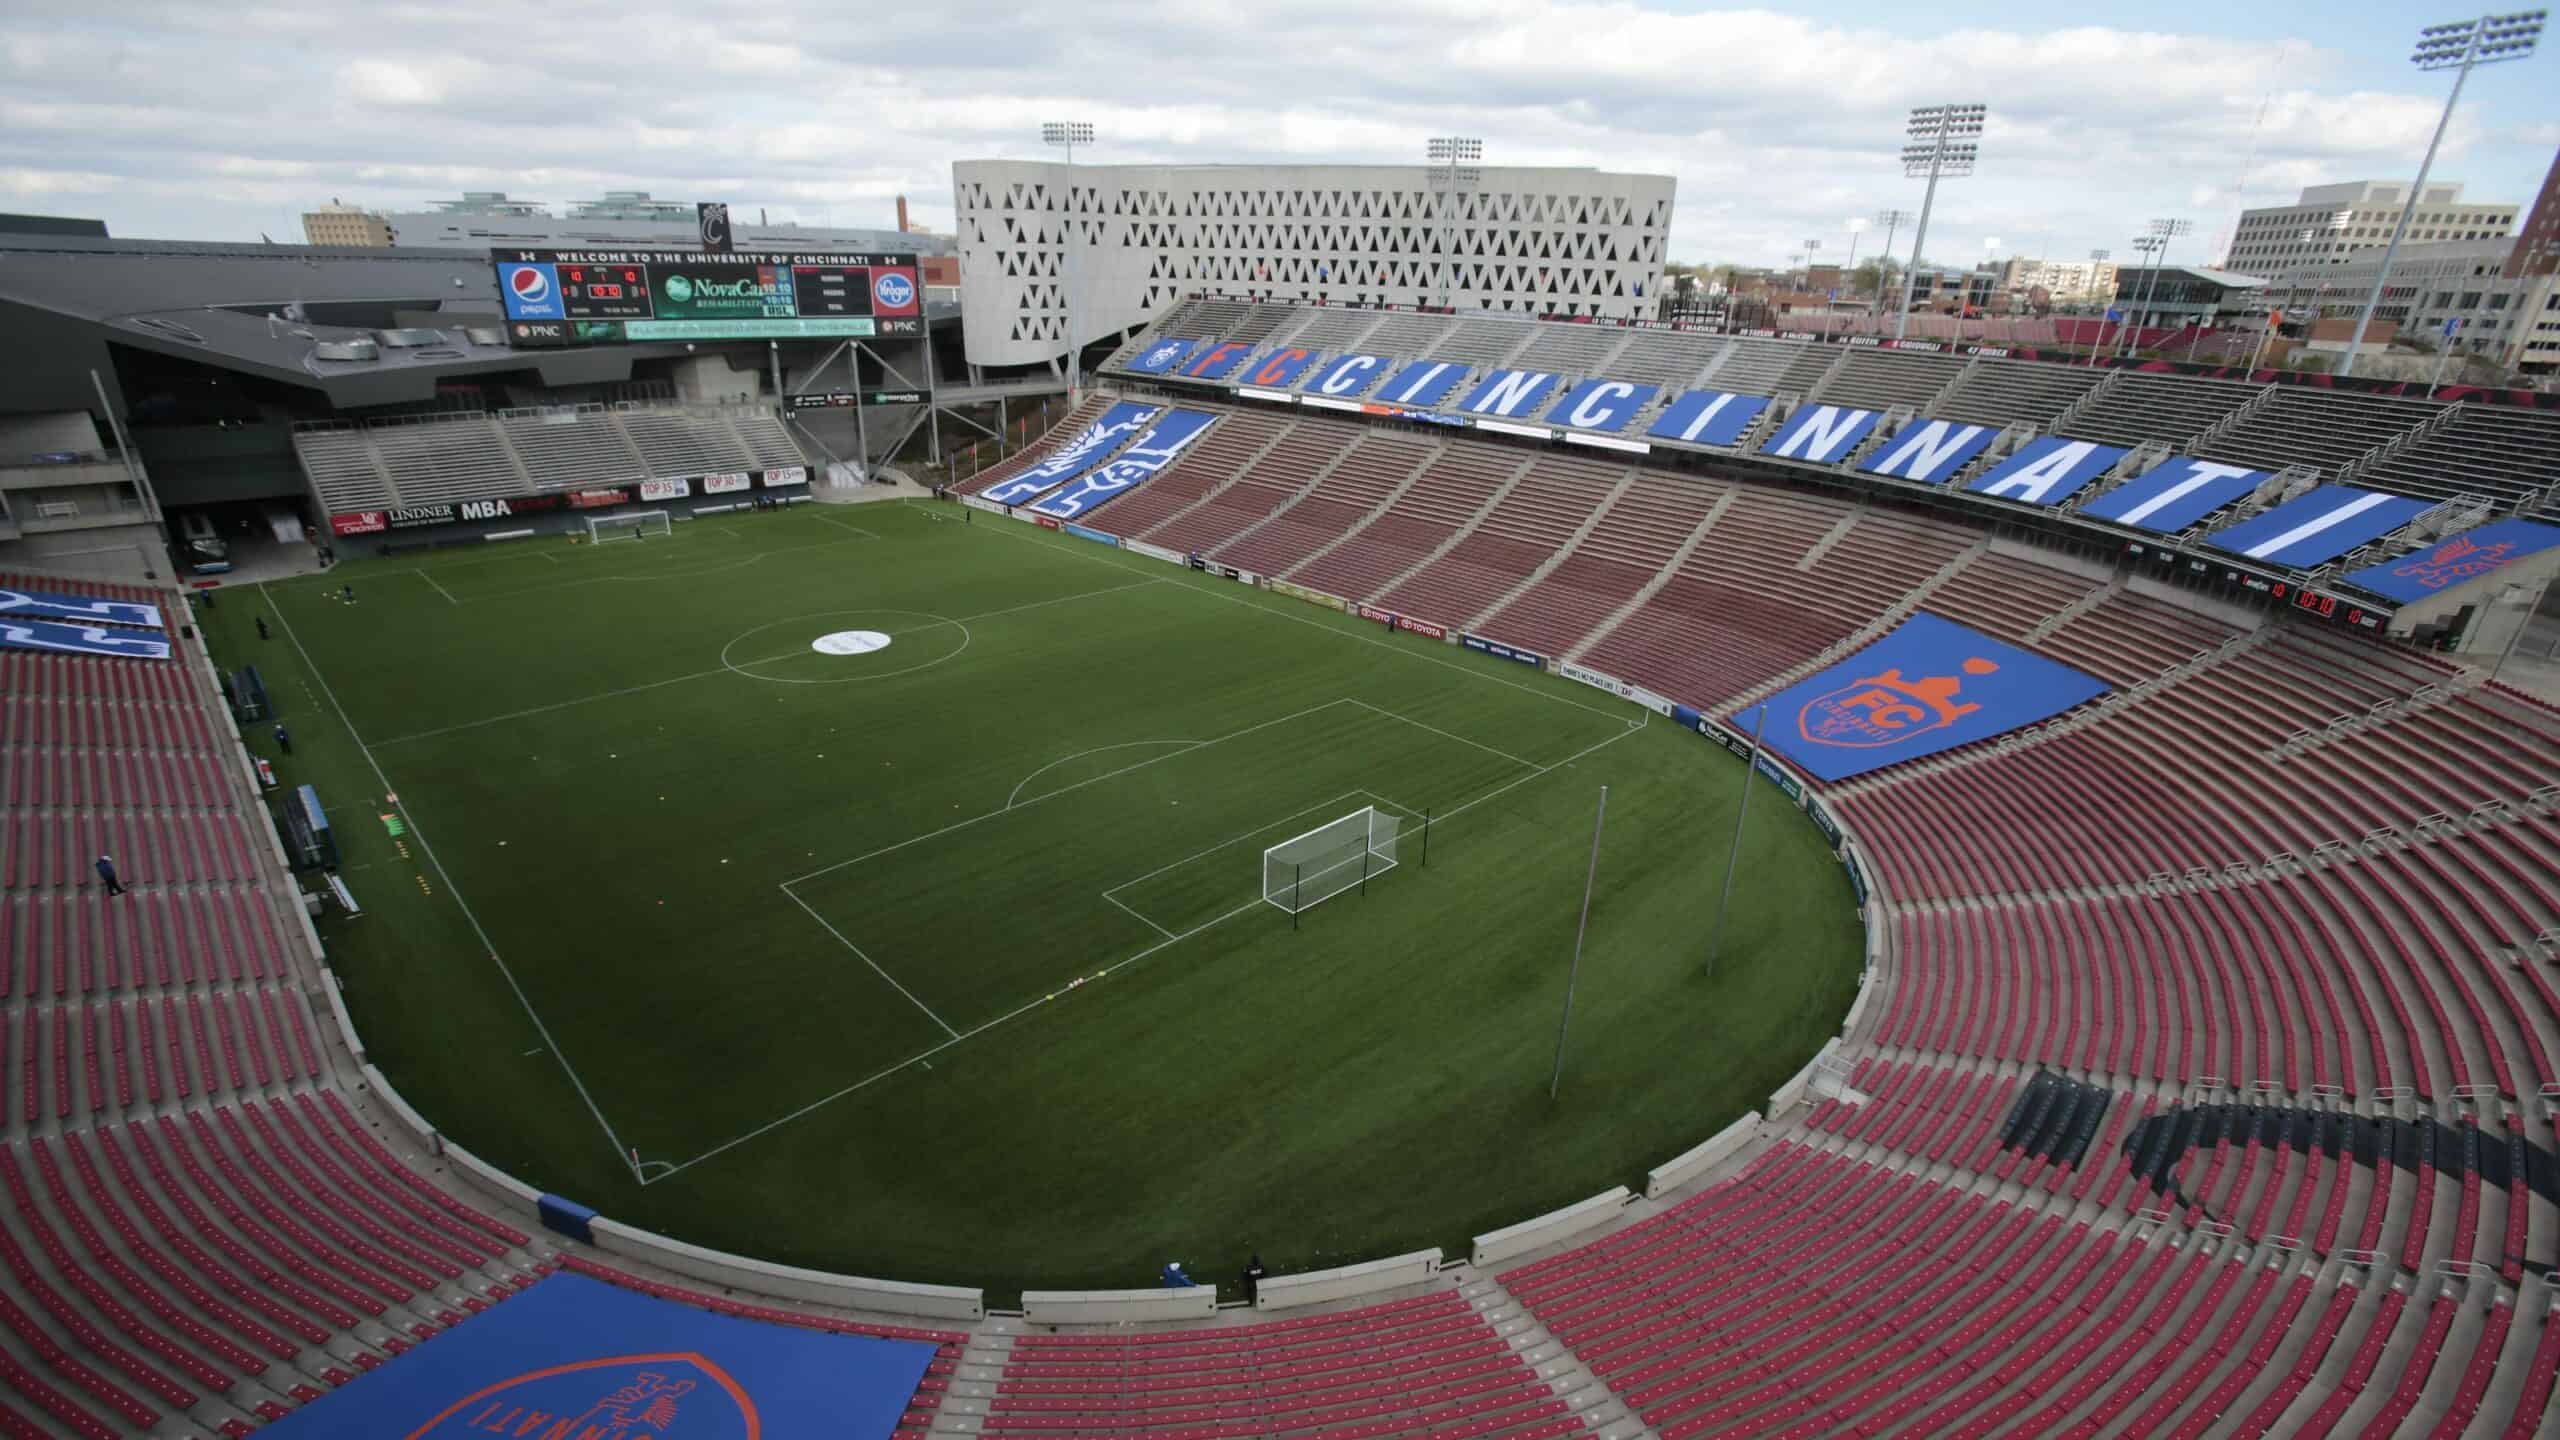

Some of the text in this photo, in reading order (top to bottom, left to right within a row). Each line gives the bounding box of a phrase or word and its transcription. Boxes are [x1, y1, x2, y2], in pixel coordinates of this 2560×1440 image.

[556, 252, 869, 266] WELCOME TO THE UNIVERSITY OF CINCINNATI
[694, 278, 764, 297] NovaCar
[530, 325, 561, 337] PNC
[894, 320, 917, 332] PNC
[707, 477, 721, 488] TOP
[767, 470, 781, 481] TOP
[644, 484, 659, 495] TOP
[388, 504, 453, 521] LINDNER
[460, 499, 512, 521] MBA
[1413, 623, 1441, 638] TOYOTA
[1840, 688, 1926, 729] FC
